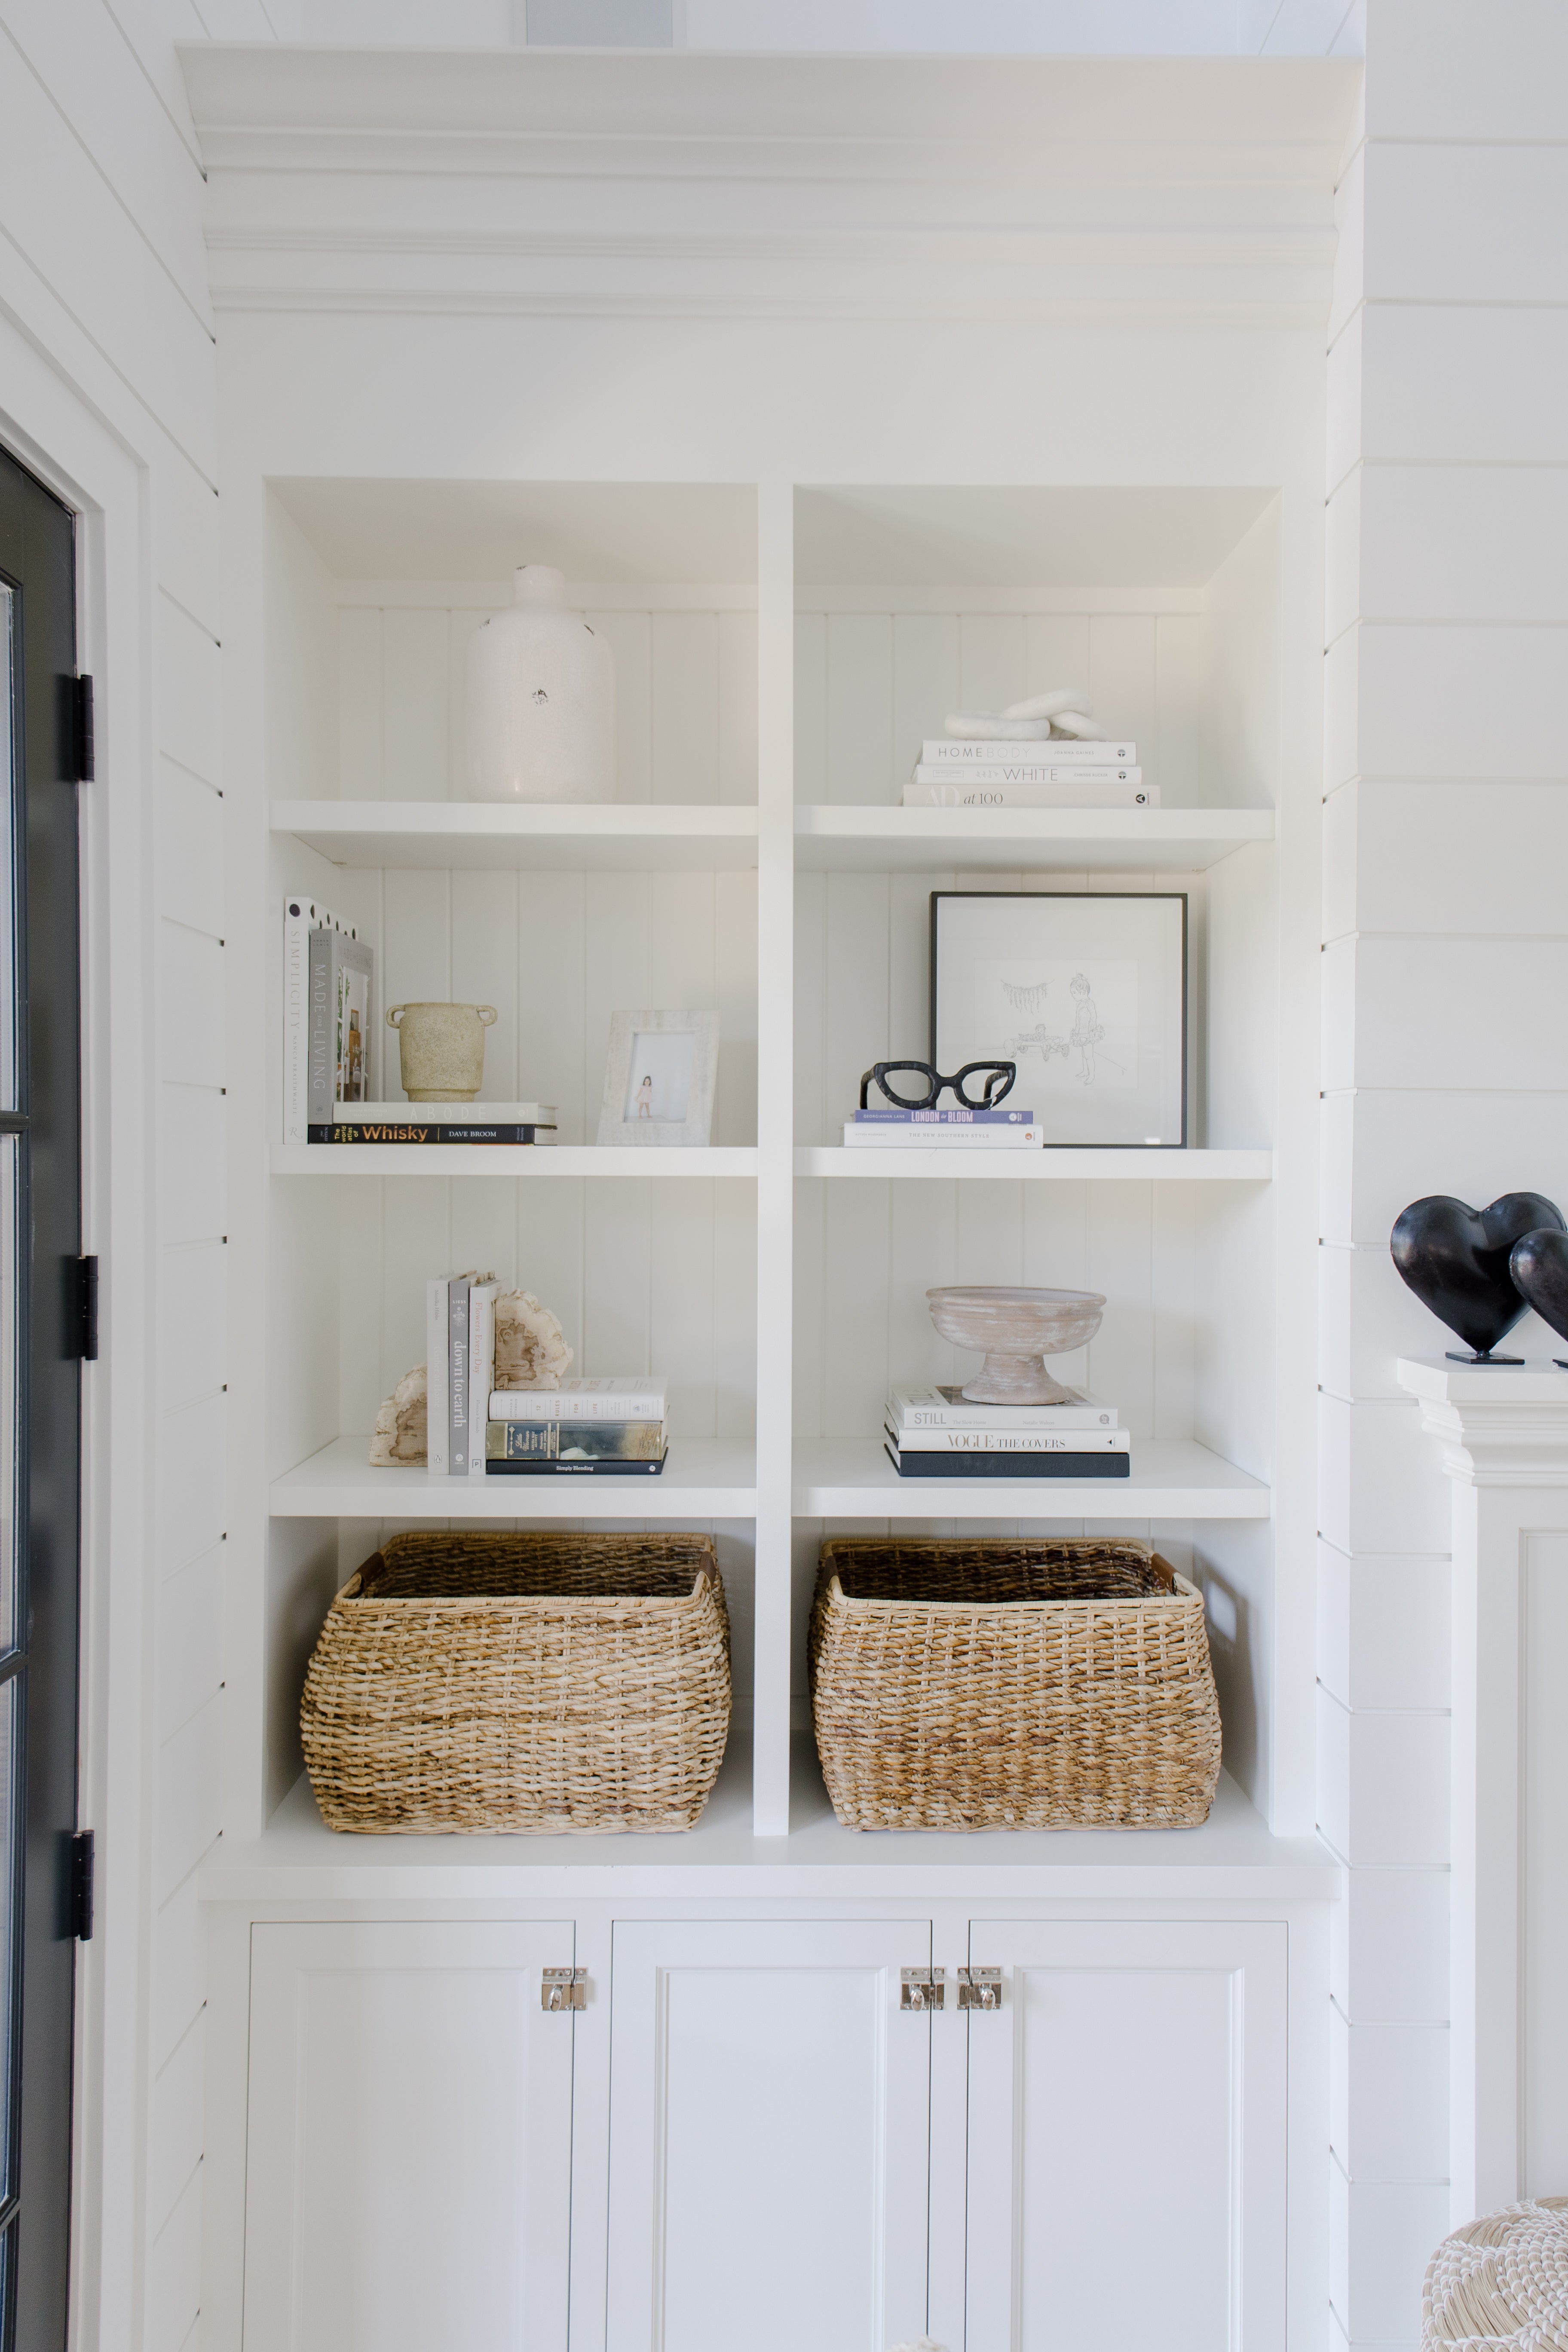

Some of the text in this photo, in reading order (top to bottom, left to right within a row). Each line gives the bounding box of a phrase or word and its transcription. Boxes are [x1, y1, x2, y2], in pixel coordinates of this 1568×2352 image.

[1003, 768, 1058, 781] WHITE
[924, 786, 1003, 808] AD at 100
[291, 931, 300, 1029] SIMPLICITY
[315, 964, 326, 1013] MADE
[313, 1031, 326, 1089] LIVING
[410, 1106, 487, 1120] ABODE
[911, 1111, 940, 1122] LONDON
[948, 1111, 974, 1122] BLOOM
[362, 1125, 429, 1142] Whisky
[472, 1334, 483, 1356] Every
[473, 1358, 482, 1374] Day
[454, 1341, 467, 1427] down to earth
[914, 1412, 947, 1424] STILL
[947, 1434, 1066, 1448] VOGUE THE COVERS
